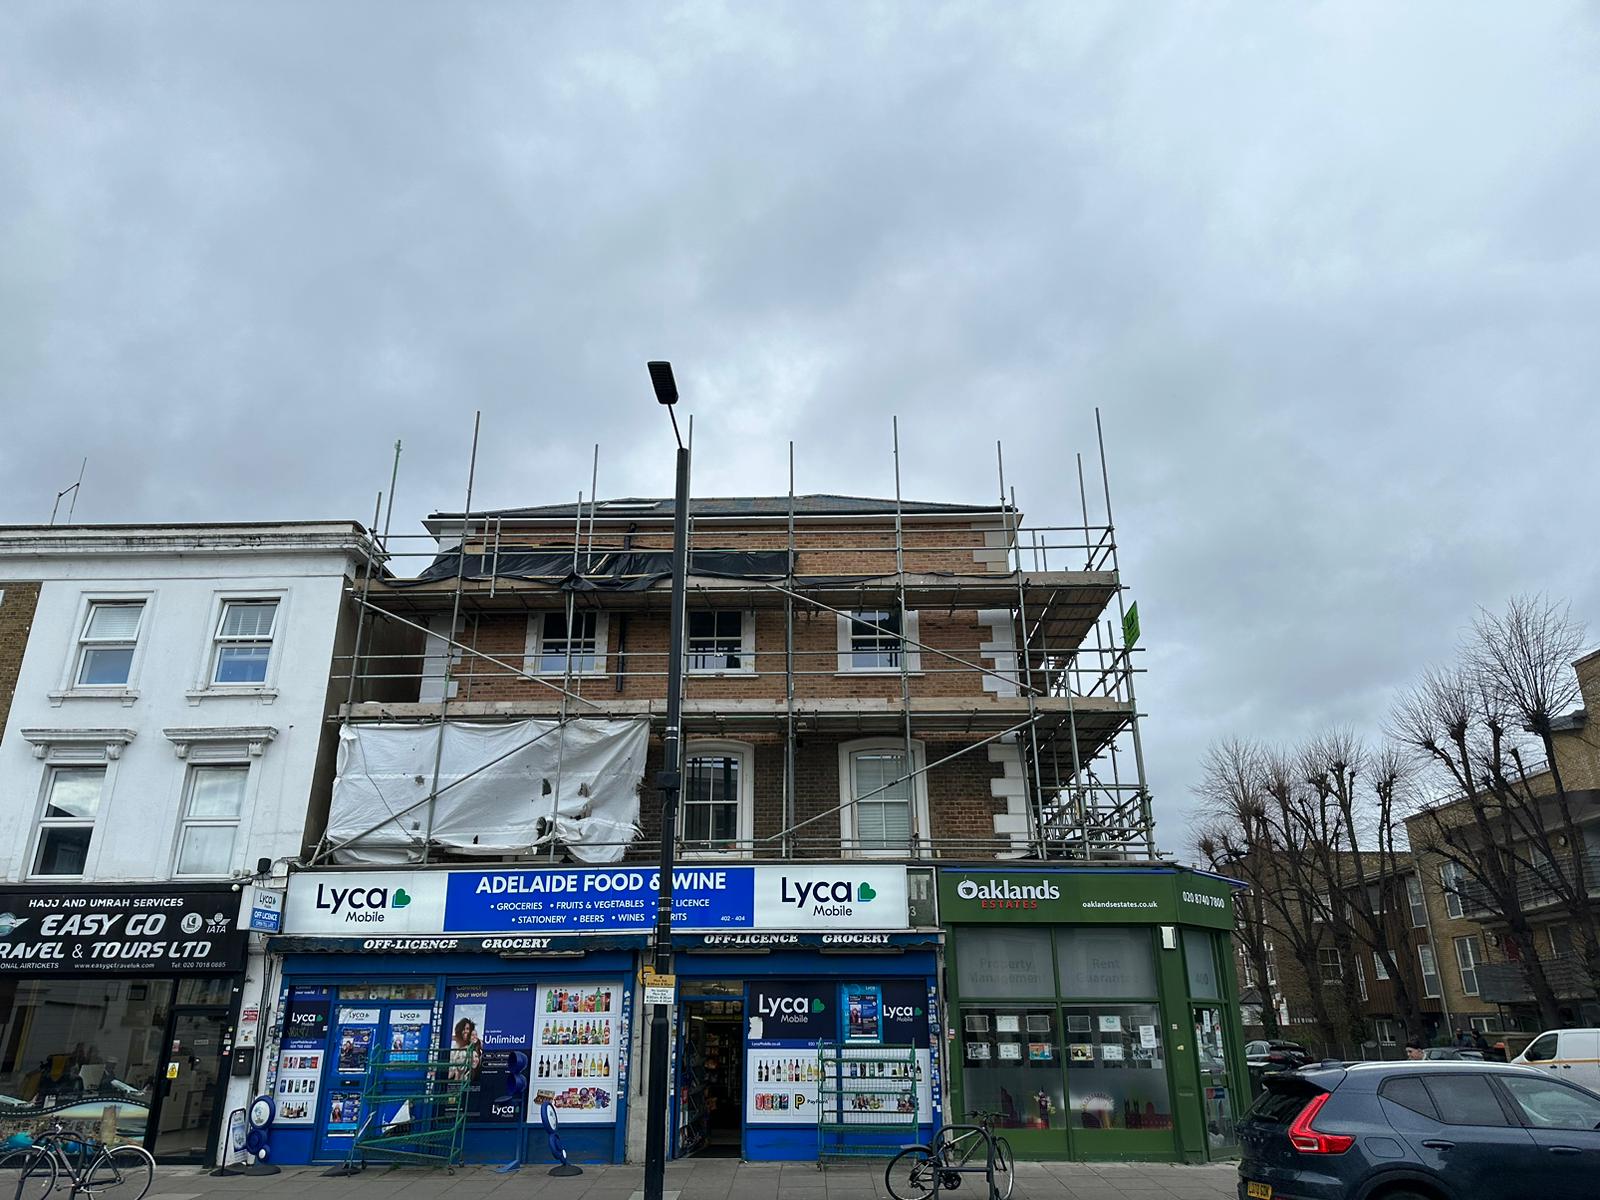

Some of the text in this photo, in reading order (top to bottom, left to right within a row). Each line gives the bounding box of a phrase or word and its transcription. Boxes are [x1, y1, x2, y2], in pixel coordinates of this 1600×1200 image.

[475, 874, 578, 894] ADELAIDE
[583, 873, 644, 892] FOOD
[671, 872, 727, 890] WINE
[957, 876, 1060, 900] Oaklands
[781, 876, 853, 908] Lyca
[28, 898, 184, 908] HAJJ AND UMRAH SERVICES
[316, 883, 389, 914] Lyca
[496, 902, 543, 911] GROCERIES
[556, 901, 584, 910] FRUITS
[585, 901, 592, 909] &
[594, 900, 645, 909] VEGETABLES
[676, 898, 710, 907] LICENCE
[813, 905, 853, 917] Mobile
[981, 900, 1038, 910] ESTATES
[345, 911, 385, 923] Mobile
[517, 915, 567, 924] STATIONERY
[579, 914, 605, 923] BEERS
[617, 913, 645, 922] WINES
[40, 914, 124, 936] EASY
[125, 913, 167, 936] GO
[206, 925, 226, 934] IATA
[363, 938, 551, 950] OFF-LICENCE GROCERY
[704, 934, 891, 944] OFF-LICENCE GROCERY
[72, 943, 83, 959] &
[90, 942, 167, 959] TOURS
[168, 941, 212, 958] LTD
[759, 993, 809, 1017] Lyca
[883, 1004, 913, 1019] Lyca
[292, 1012, 317, 1024] Lyca
[781, 1014, 809, 1023] Mobile
[484, 1034, 526, 1044] Unlimited
[491, 1104, 514, 1115] Lyca
